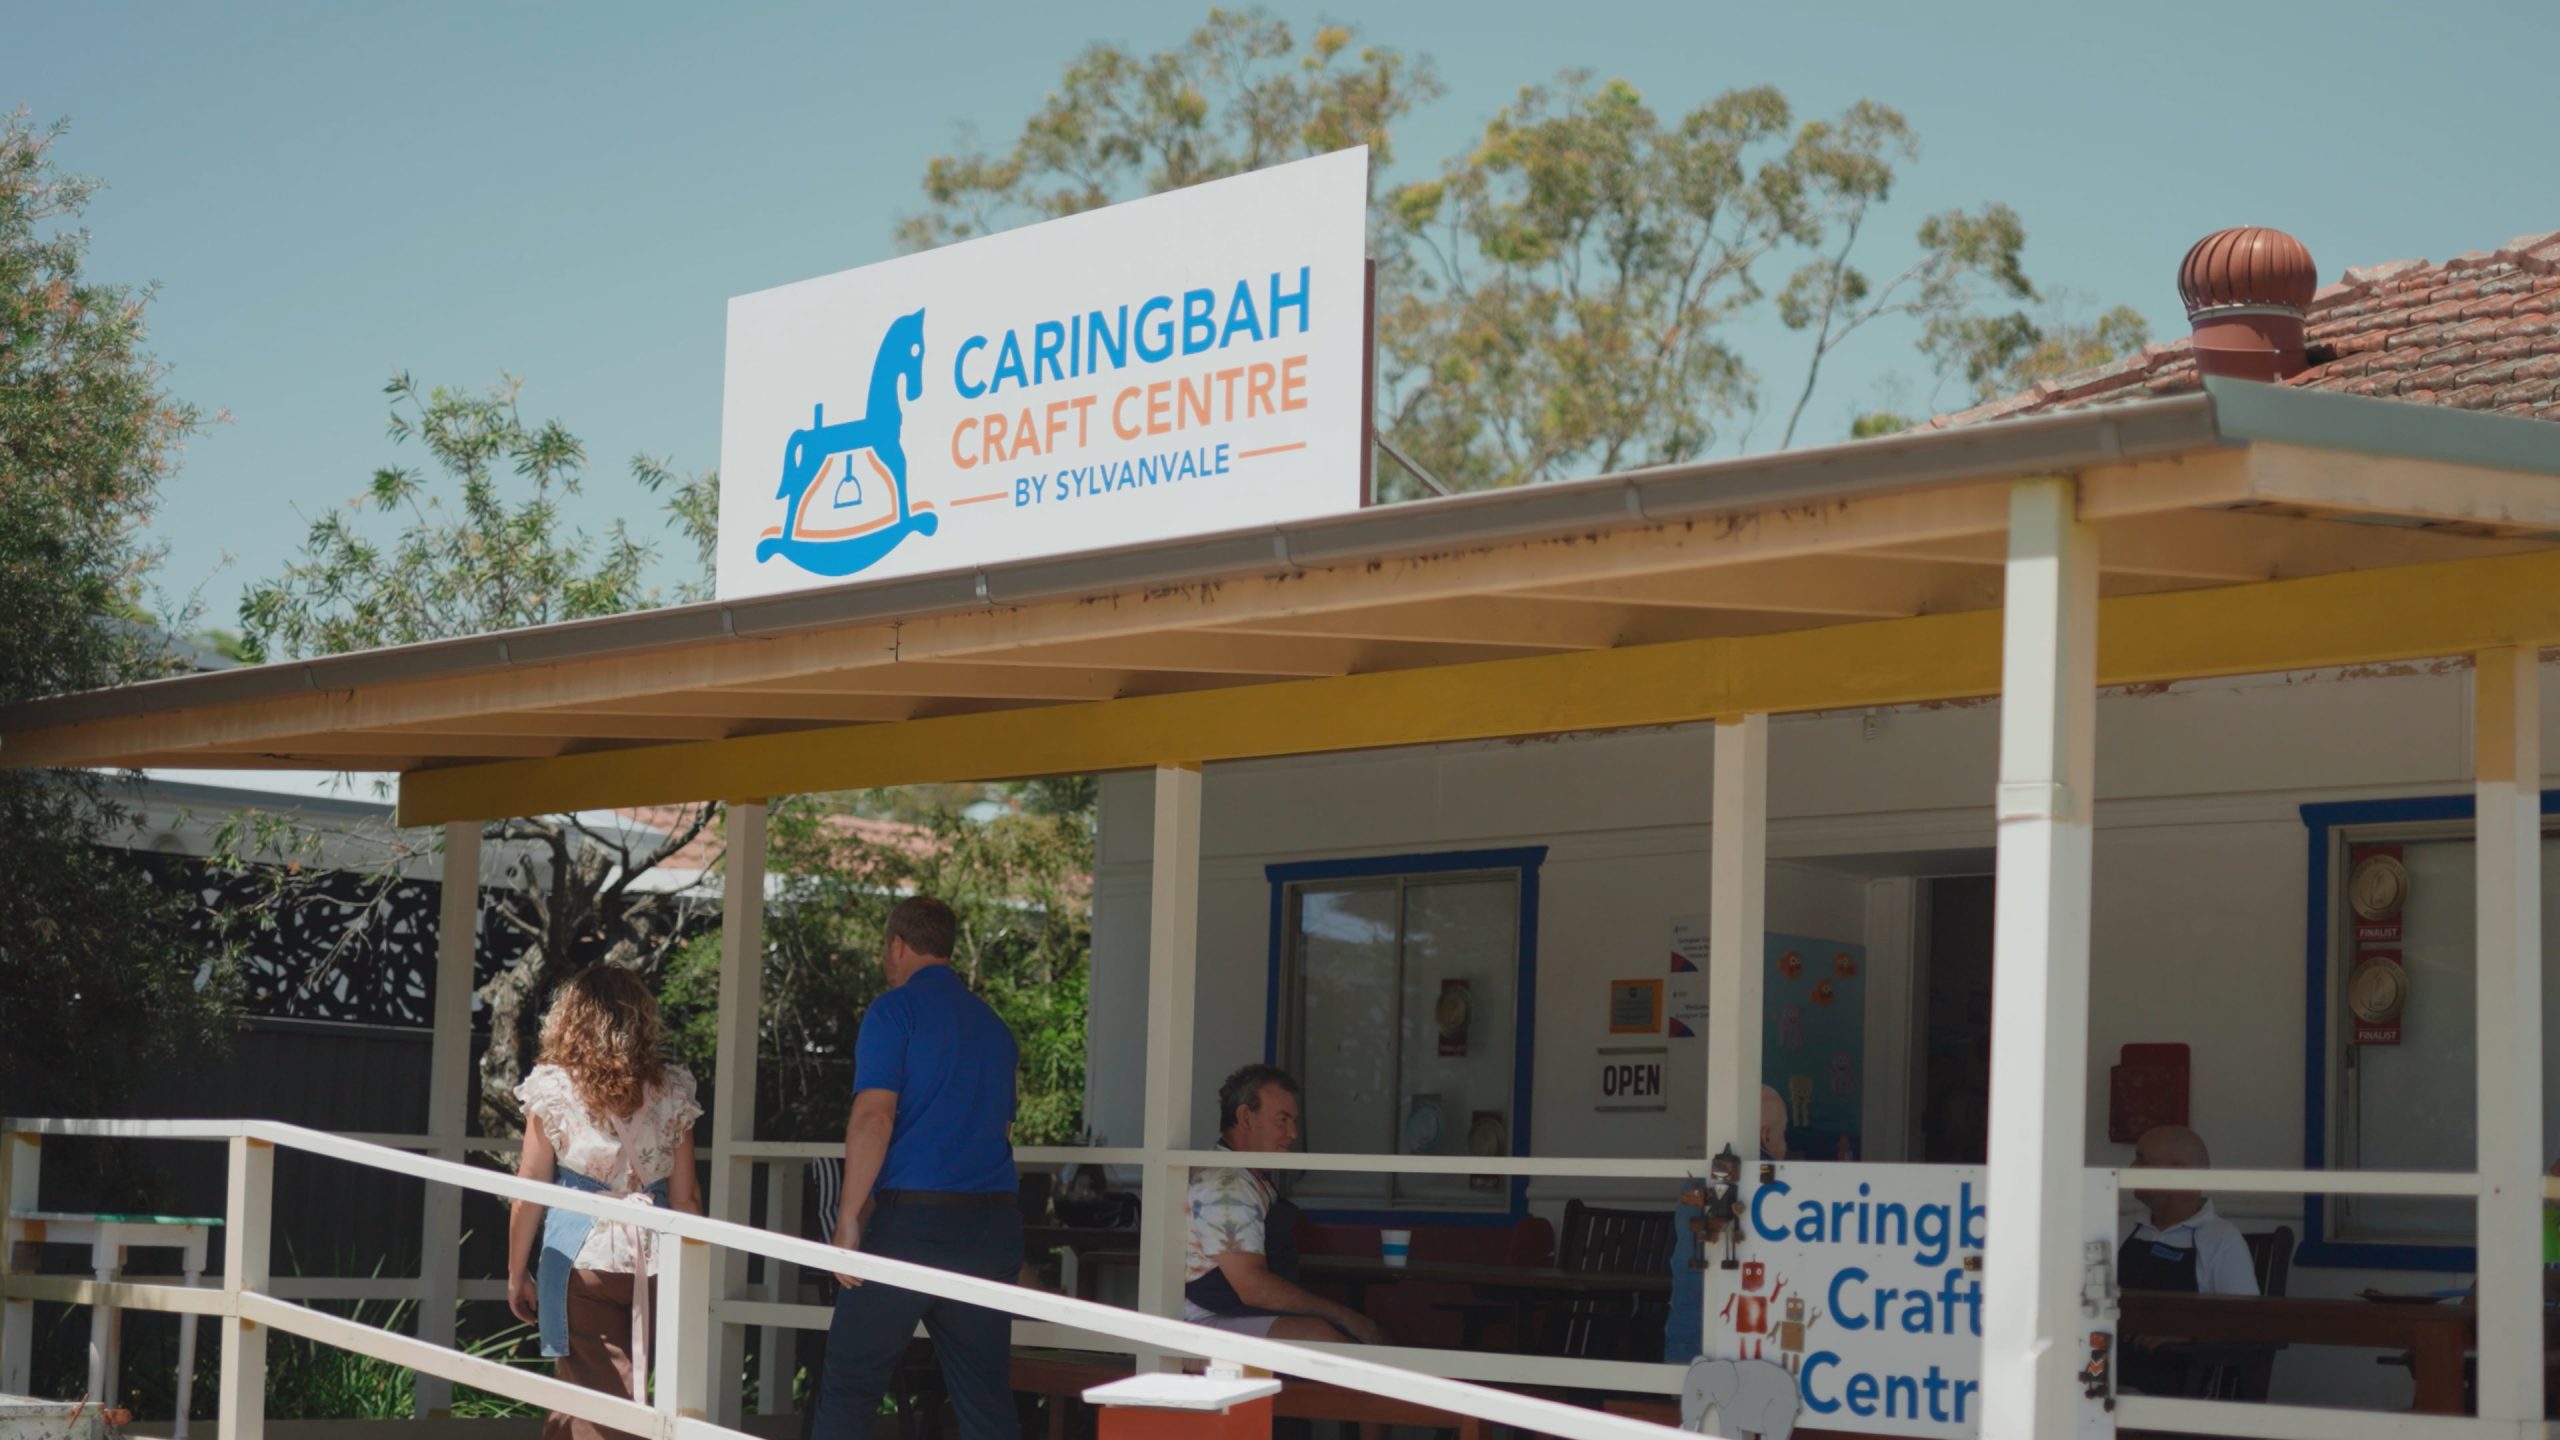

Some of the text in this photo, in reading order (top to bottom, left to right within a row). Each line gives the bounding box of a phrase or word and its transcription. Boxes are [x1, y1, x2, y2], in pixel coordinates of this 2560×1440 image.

[953, 265, 1311, 399] CARINGBAH
[951, 354, 1309, 470] CRAFT CENTRE
[1014, 443, 1231, 507] BY SYLVANVALE
[2359, 927, 2398, 938] FINALIST
[2358, 1030, 2397, 1041] FINALIST
[1603, 1064, 1660, 1096] OPEN
[1751, 1180, 1986, 1267] Caringb
[1800, 1351, 1978, 1423] Centr
